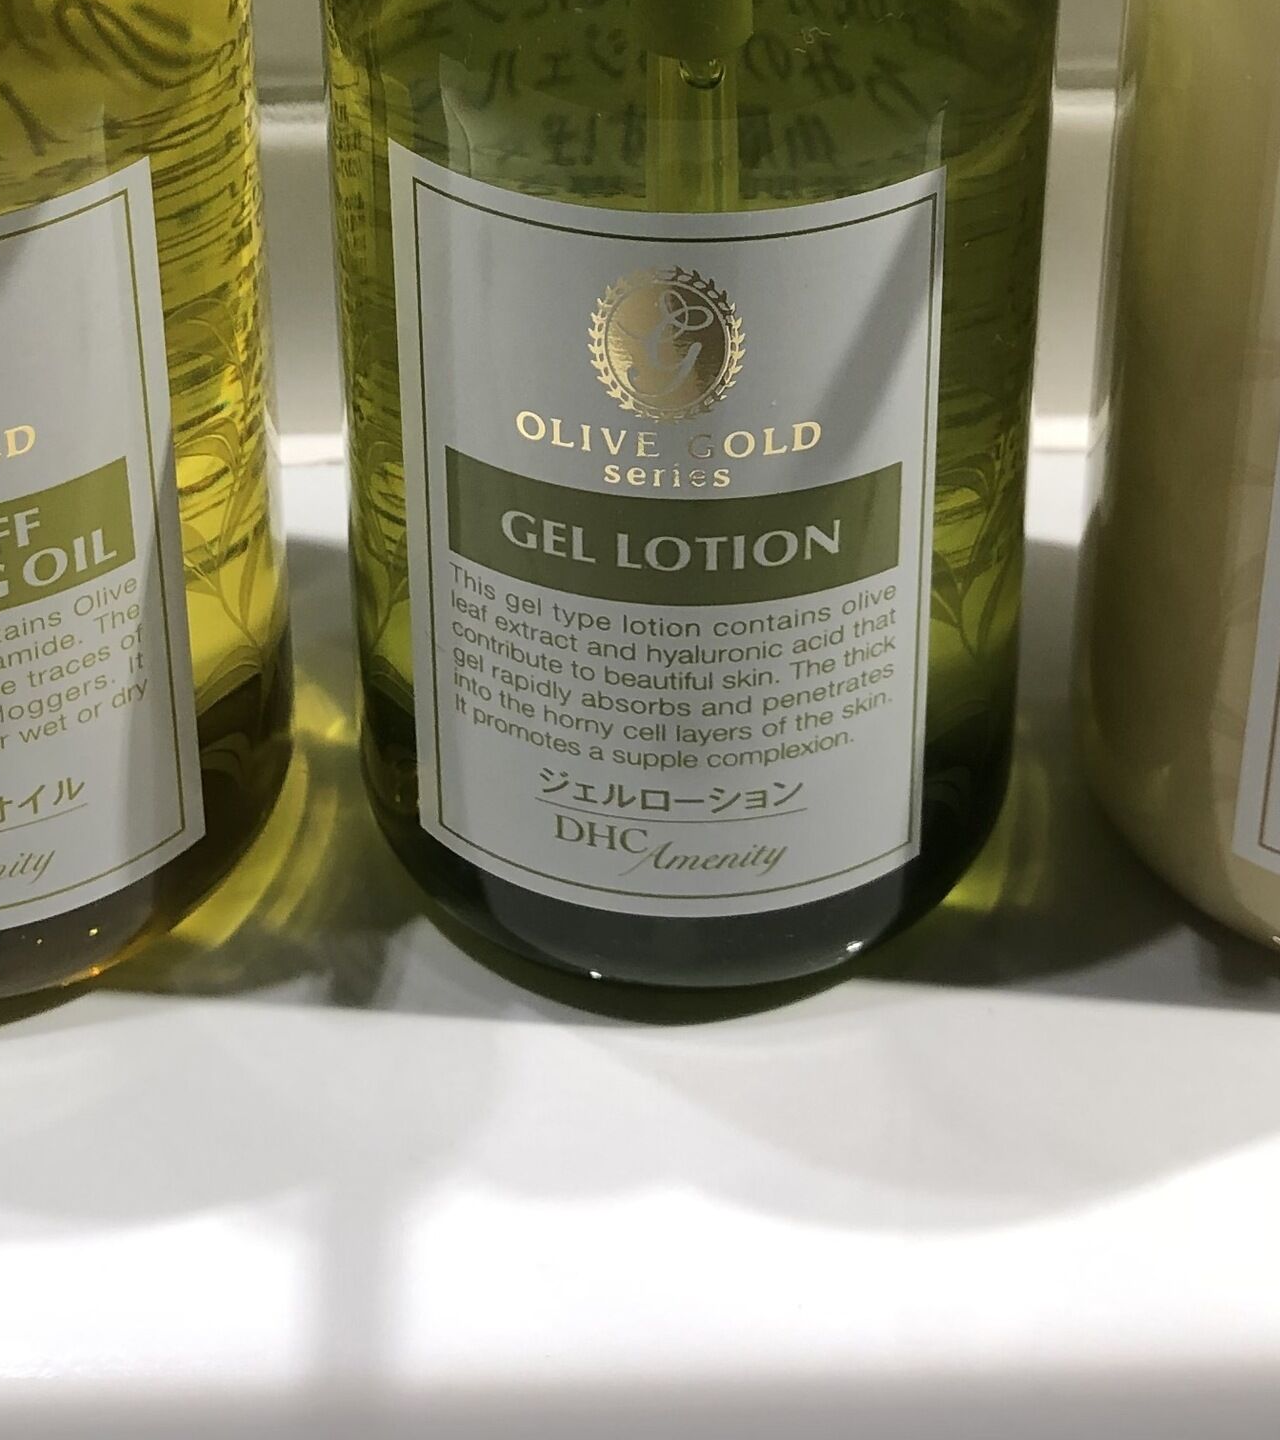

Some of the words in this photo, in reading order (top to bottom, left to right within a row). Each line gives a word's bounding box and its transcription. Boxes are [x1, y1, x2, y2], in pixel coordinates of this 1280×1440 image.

[516, 410, 660, 458] OLIVE
[688, 421, 822, 459] GOLD
[603, 463, 731, 489] series
[23, 527, 118, 589] OIL
[501, 510, 597, 563] GEL
[617, 519, 841, 572] LOTION
[73, 577, 138, 617] Olive
[93, 603, 141, 635] The
[449, 561, 496, 600] This
[505, 592, 542, 616] gel
[553, 603, 611, 631] type
[623, 615, 701, 638] lotion
[713, 606, 831, 637] contains
[842, 585, 897, 615] olive
[451, 590, 488, 623] leaf
[495, 615, 578, 652] extract
[587, 643, 636, 661] and
[647, 641, 783, 668] hyaluronic
[792, 625, 845, 654] acid
[854, 609, 896, 638] that
[27, 646, 111, 688] traces
[120, 623, 143, 650] of
[128, 652, 144, 674] It
[452, 621, 563, 674] contribute
[571, 661, 595, 681] to
[605, 666, 713, 690] beautiful
[722, 668, 780, 689] skin.
[790, 658, 836, 680] The
[844, 635, 896, 667] thick
[453, 647, 484, 672] gel
[492, 665, 571, 706] rapidly
[581, 691, 691, 717] absorbs
[701, 696, 752, 717] and
[763, 663, 894, 715] penetrates
[18, 714, 67, 743] wet
[77, 702, 102, 724] or
[111, 678, 148, 710] dry
[454, 668, 492, 701] into
[499, 690, 535, 718] the
[544, 705, 614, 740] horny
[623, 724, 666, 742] cell
[676, 725, 752, 746] layers
[762, 716, 787, 738] of
[795, 710, 834, 732] the
[842, 691, 893, 719] skin.
[455, 693, 467, 714] It
[473, 707, 581, 756] promotes
[589, 746, 604, 761] a
[613, 749, 698, 772] supple
[707, 731, 855, 767] complexion.
[539, 766, 804, 815] ジェルローション
[554, 813, 650, 855] DHC
[619, 841, 789, 877] Amenity
